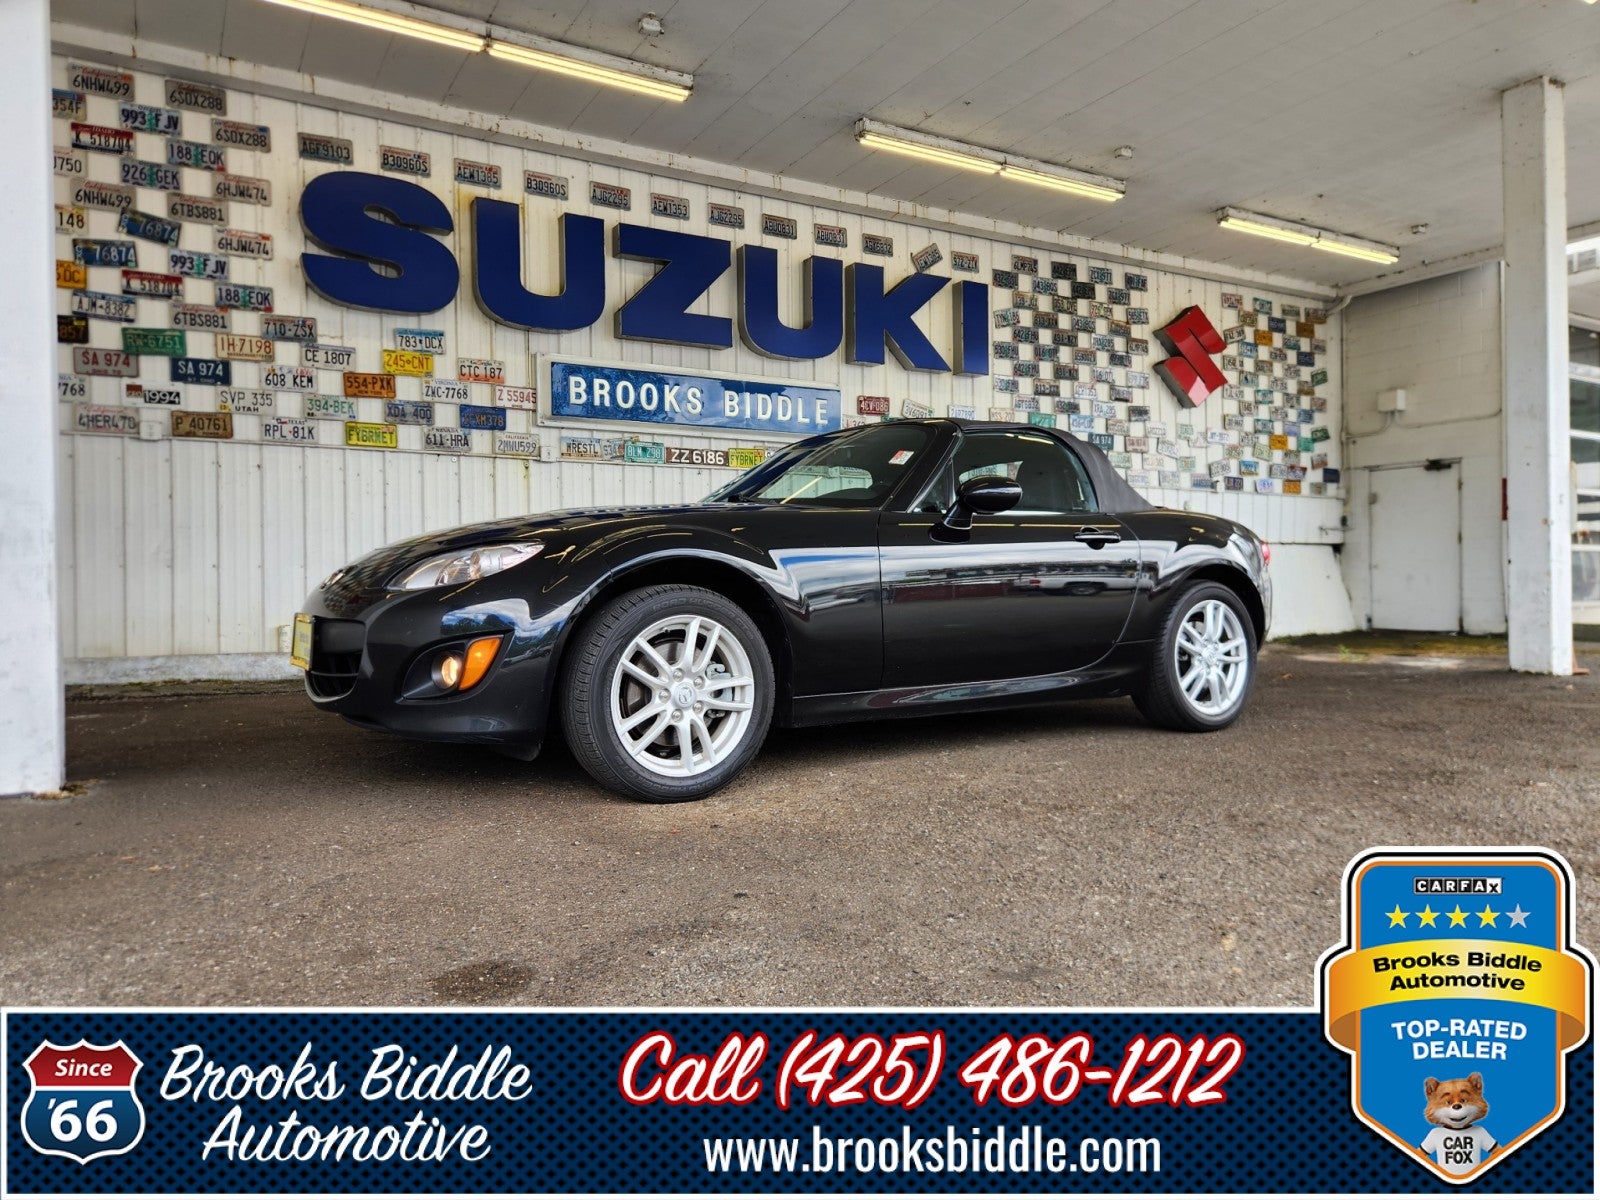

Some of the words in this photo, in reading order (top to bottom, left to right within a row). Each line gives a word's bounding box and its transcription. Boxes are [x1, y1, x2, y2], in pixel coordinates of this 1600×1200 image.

[73, 75, 130, 96] 6NHW499
[121, 109, 146, 126] 993
[170, 143, 192, 161] 188
[123, 163, 147, 182] 926
[156, 168, 179, 186] GEK
[75, 189, 132, 208] 6NHW499
[216, 182, 267, 201] 6HJW474
[171, 203, 224, 221] 6TBS881
[217, 237, 269, 256] 6HJW474
[170, 255, 194, 271] 993
[300, 171, 988, 375] SUZUKI
[219, 287, 240, 303] 188
[174, 312, 227, 329] 6TBS881
[399, 335, 418, 349] 783
[82, 351, 99, 367] SA
[105, 353, 130, 368] 974
[305, 349, 319, 363] CE
[324, 351, 351, 366] 1807
[386, 353, 405, 368] 245
[412, 356, 431, 371] CNT
[178, 361, 195, 376] SA
[199, 362, 224, 377] 974
[460, 364, 480, 378] CTC
[483, 367, 502, 380] 187
[265, 373, 287, 388] 608
[293, 375, 314, 389] KEM
[144, 390, 181, 405] 1994
[220, 390, 246, 406] SVP
[252, 393, 272, 408] 335
[498, 388, 504, 401] Z
[569, 376, 703, 415] BROOKS
[724, 390, 828, 425] BIDDLE
[175, 416, 182, 431] P
[189, 417, 228, 433] 40761
[264, 424, 287, 439] RPL
[292, 425, 315, 440] 81K
[566, 442, 599, 455] WRESTL
[671, 450, 690, 463] ZZ
[692, 450, 725, 465] 6186
